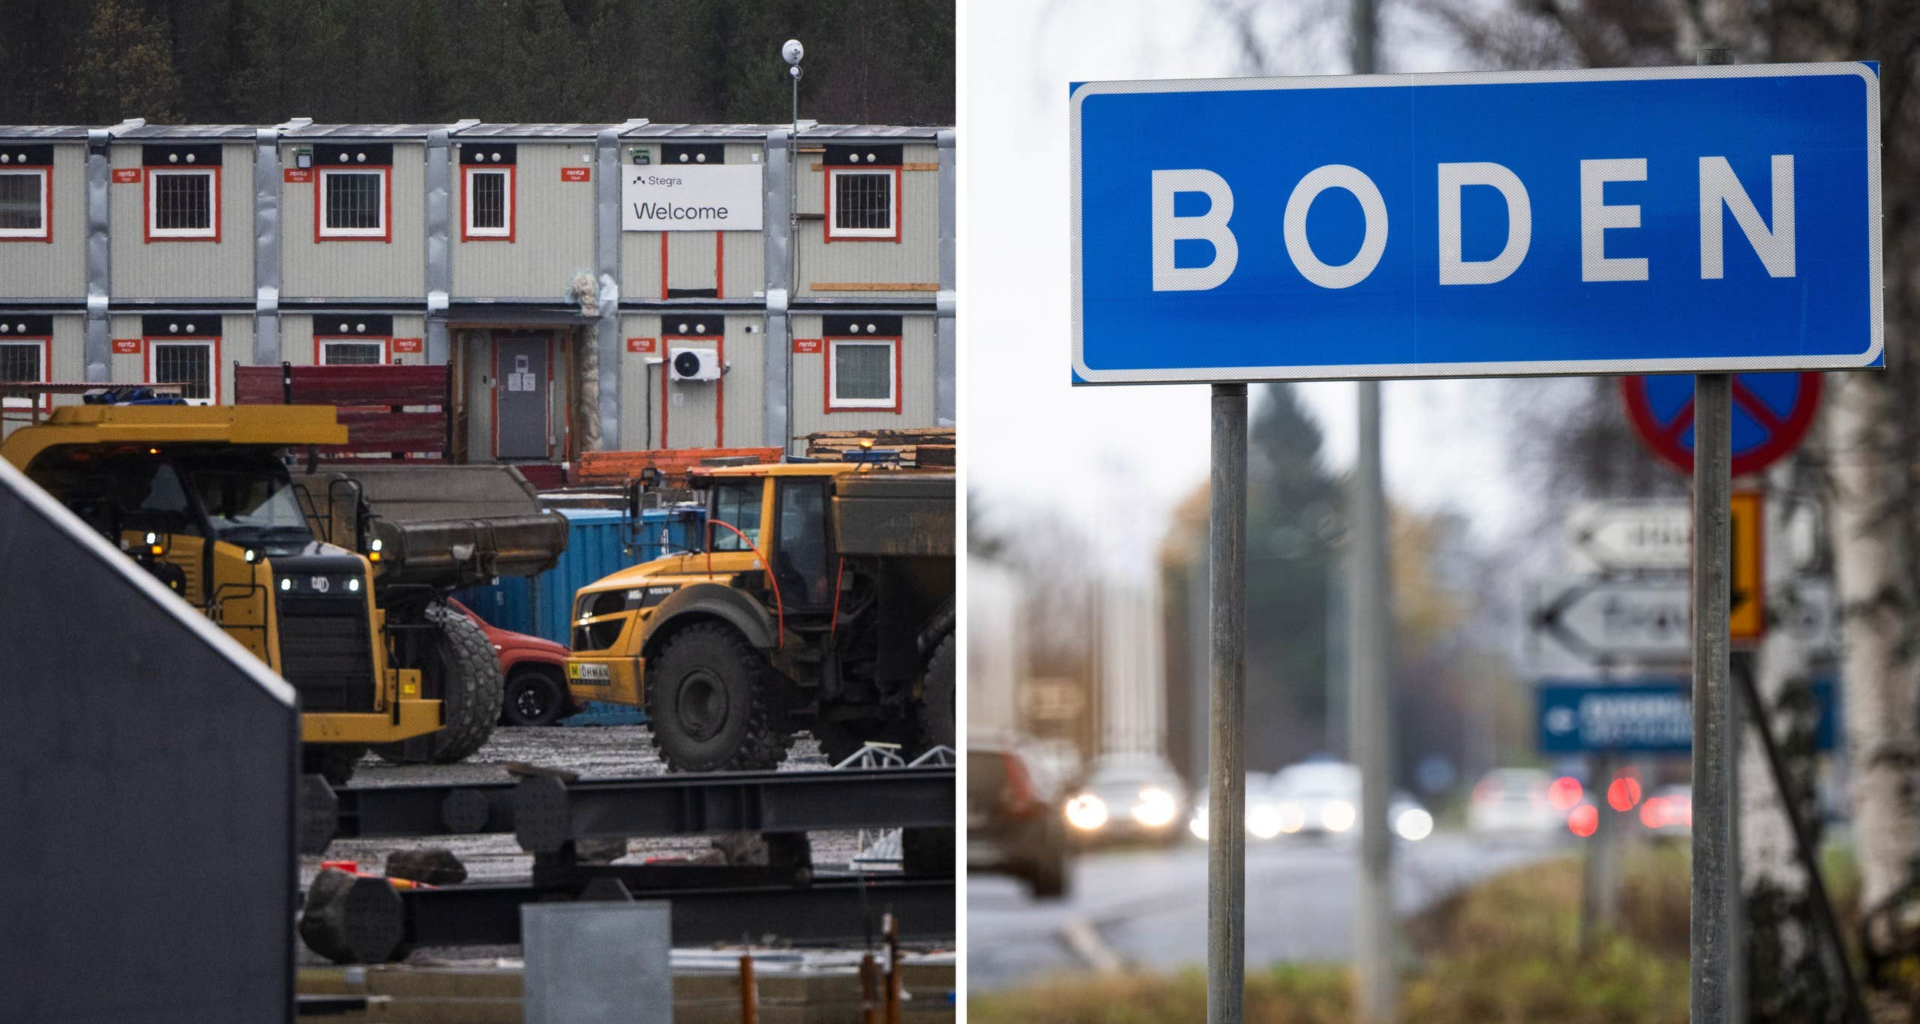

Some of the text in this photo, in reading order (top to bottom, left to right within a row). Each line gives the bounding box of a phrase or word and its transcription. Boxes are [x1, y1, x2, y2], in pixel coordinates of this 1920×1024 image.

[648, 176, 683, 187] Stegra
[633, 202, 729, 220] Welcome
[1151, 153, 1797, 292] BODEN
